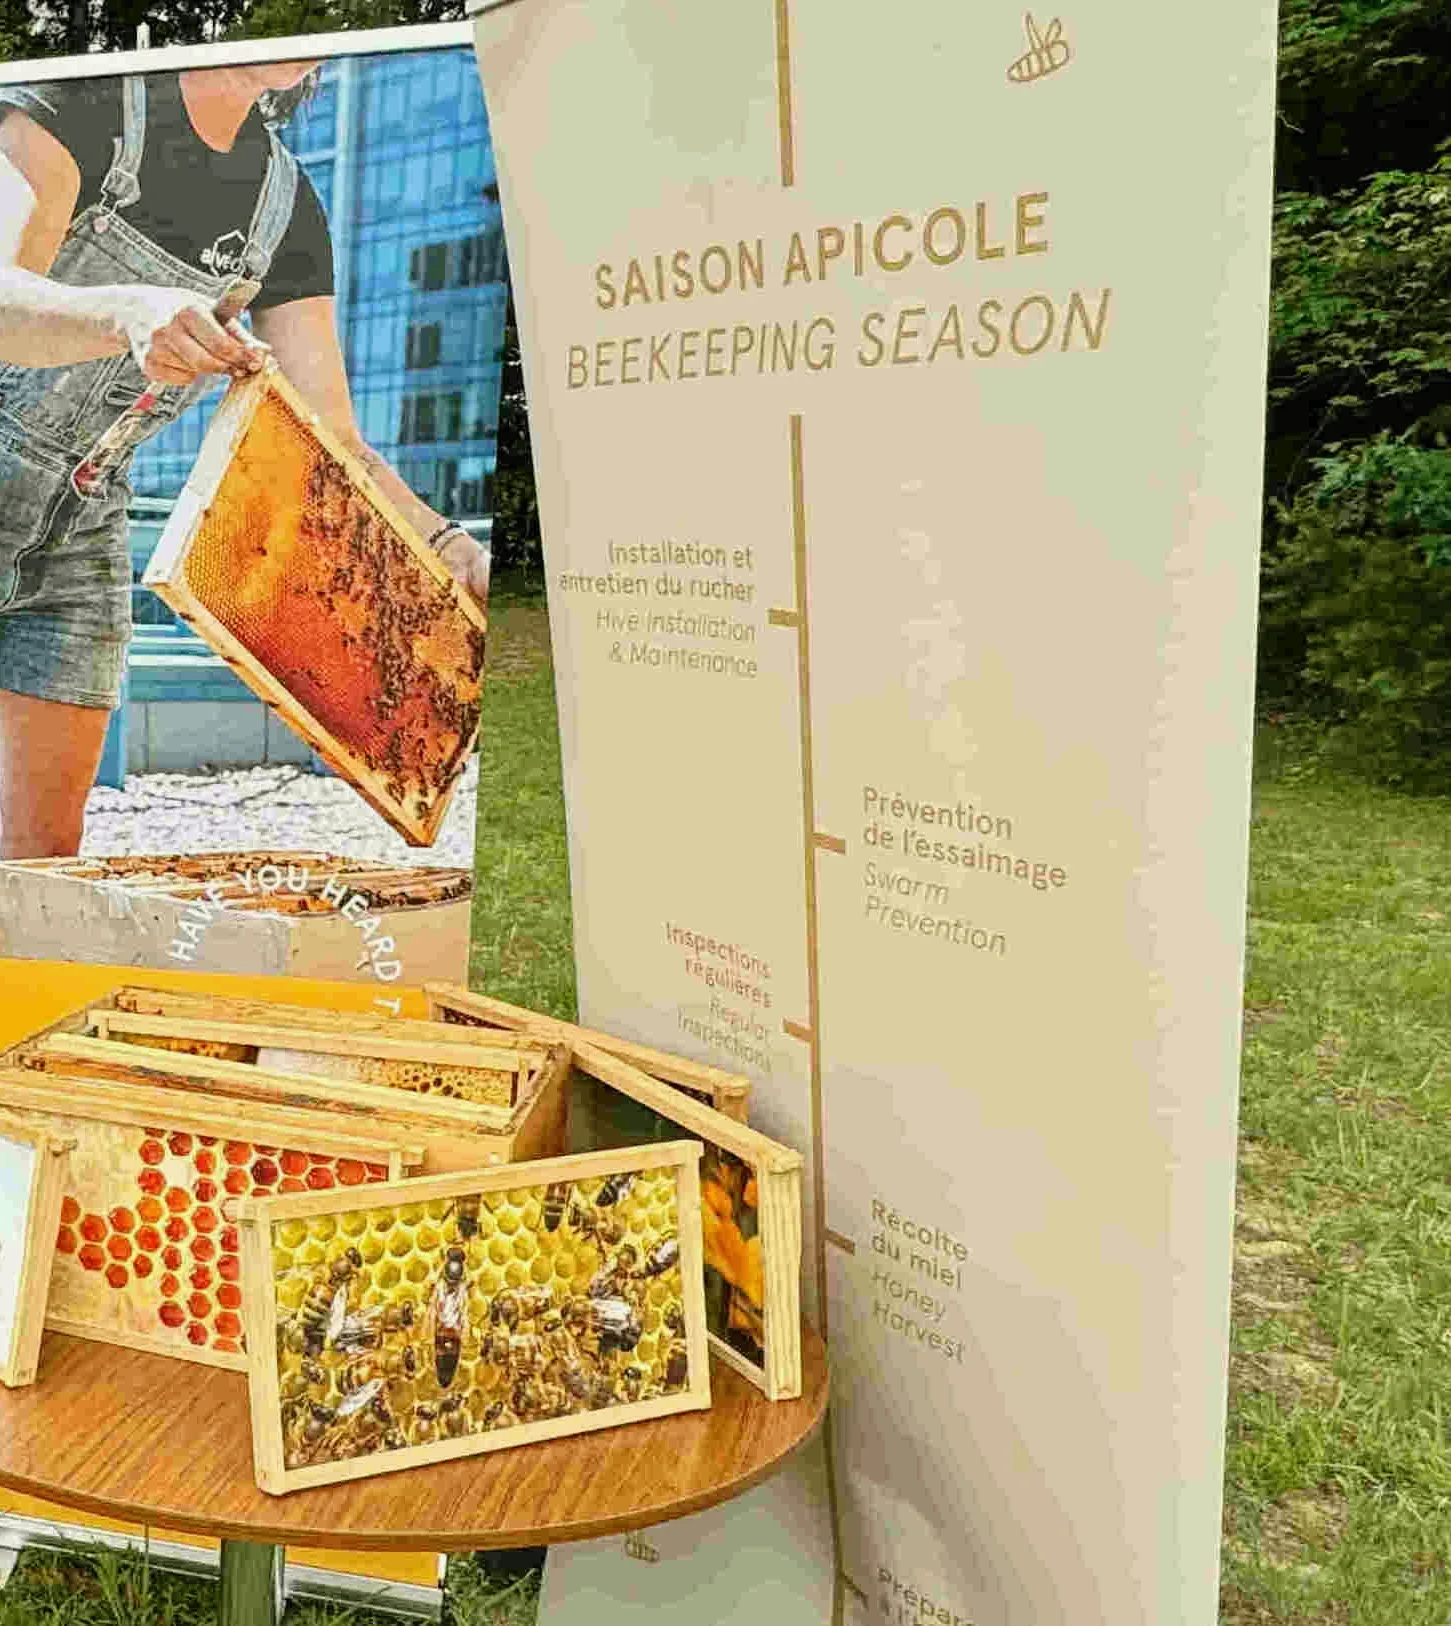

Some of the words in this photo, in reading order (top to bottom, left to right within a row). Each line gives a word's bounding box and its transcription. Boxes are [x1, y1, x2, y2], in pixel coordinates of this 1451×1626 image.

[594, 237, 766, 311] SAISON
[782, 190, 1051, 286] APICOLE
[566, 316, 837, 390] BEEKEEPING
[857, 286, 1112, 368] SEASON
[607, 539, 727, 569] Installation
[732, 544, 753, 571] et
[558, 570, 648, 597] entretien
[655, 571, 683, 597] du
[689, 576, 755, 602] rucher
[596, 607, 639, 633] Hive
[646, 610, 757, 642] Installation
[609, 640, 623, 665] &
[629, 642, 758, 679] Maintenance
[863, 785, 1013, 841] Prévention
[863, 823, 895, 849] de
[902, 827, 1067, 891] l'essaimage
[864, 861, 950, 905] Swarm
[165, 886, 227, 962] HAVE
[236, 864, 309, 894] YOU
[321, 875, 402, 982] HEARD
[664, 920, 773, 979] Inspections
[865, 895, 1007, 956] Prevention
[707, 994, 773, 1049] Regular
[871, 1198, 969, 1263] Récolte
[871, 1231, 901, 1262] du
[909, 1251, 962, 1291] miel
[871, 1269, 946, 1324] Honey
[873, 1299, 965, 1365] Harvest
